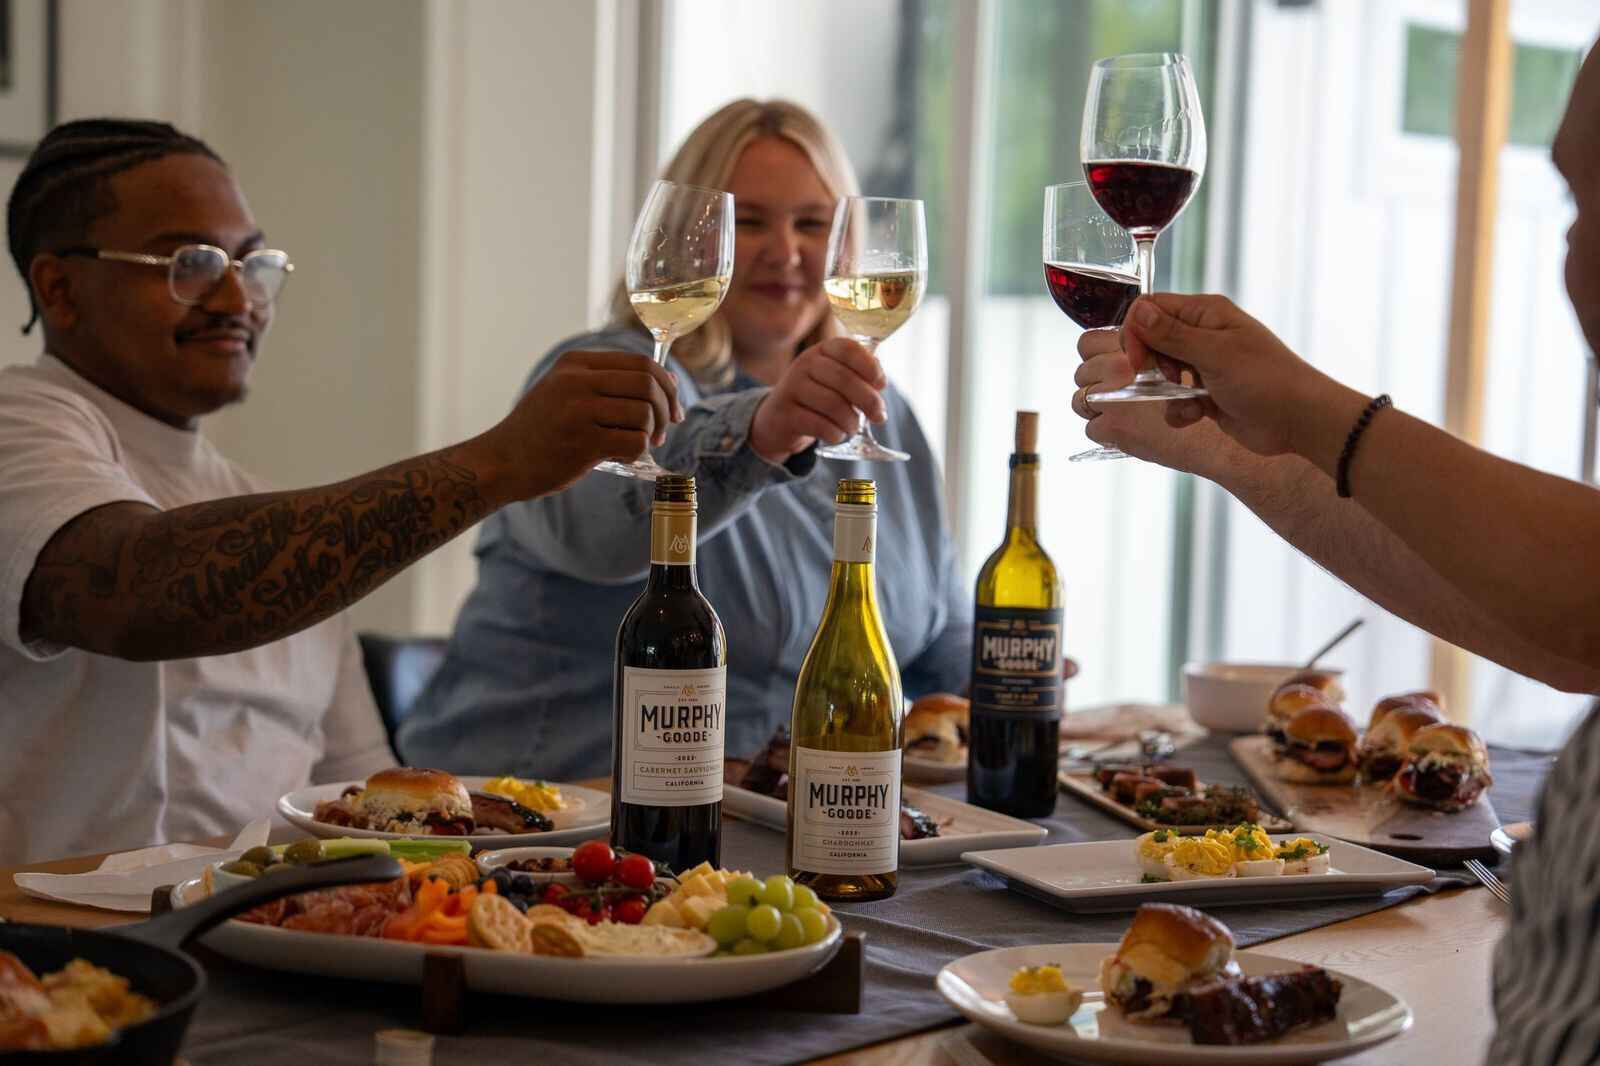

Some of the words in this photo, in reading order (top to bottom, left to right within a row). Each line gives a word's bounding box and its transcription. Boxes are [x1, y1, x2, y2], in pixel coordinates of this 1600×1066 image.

[982, 635, 1055, 662] MURPHY
[640, 703, 722, 733] MURPHY
[662, 731, 708, 743] GOODE
[639, 766, 682, 775] CABERNET
[664, 779, 704, 787] CALIFORNIA
[809, 782, 889, 809] MURPHY
[827, 808, 872, 820] GOODE
[822, 839, 874, 847] CHARDONNAY
